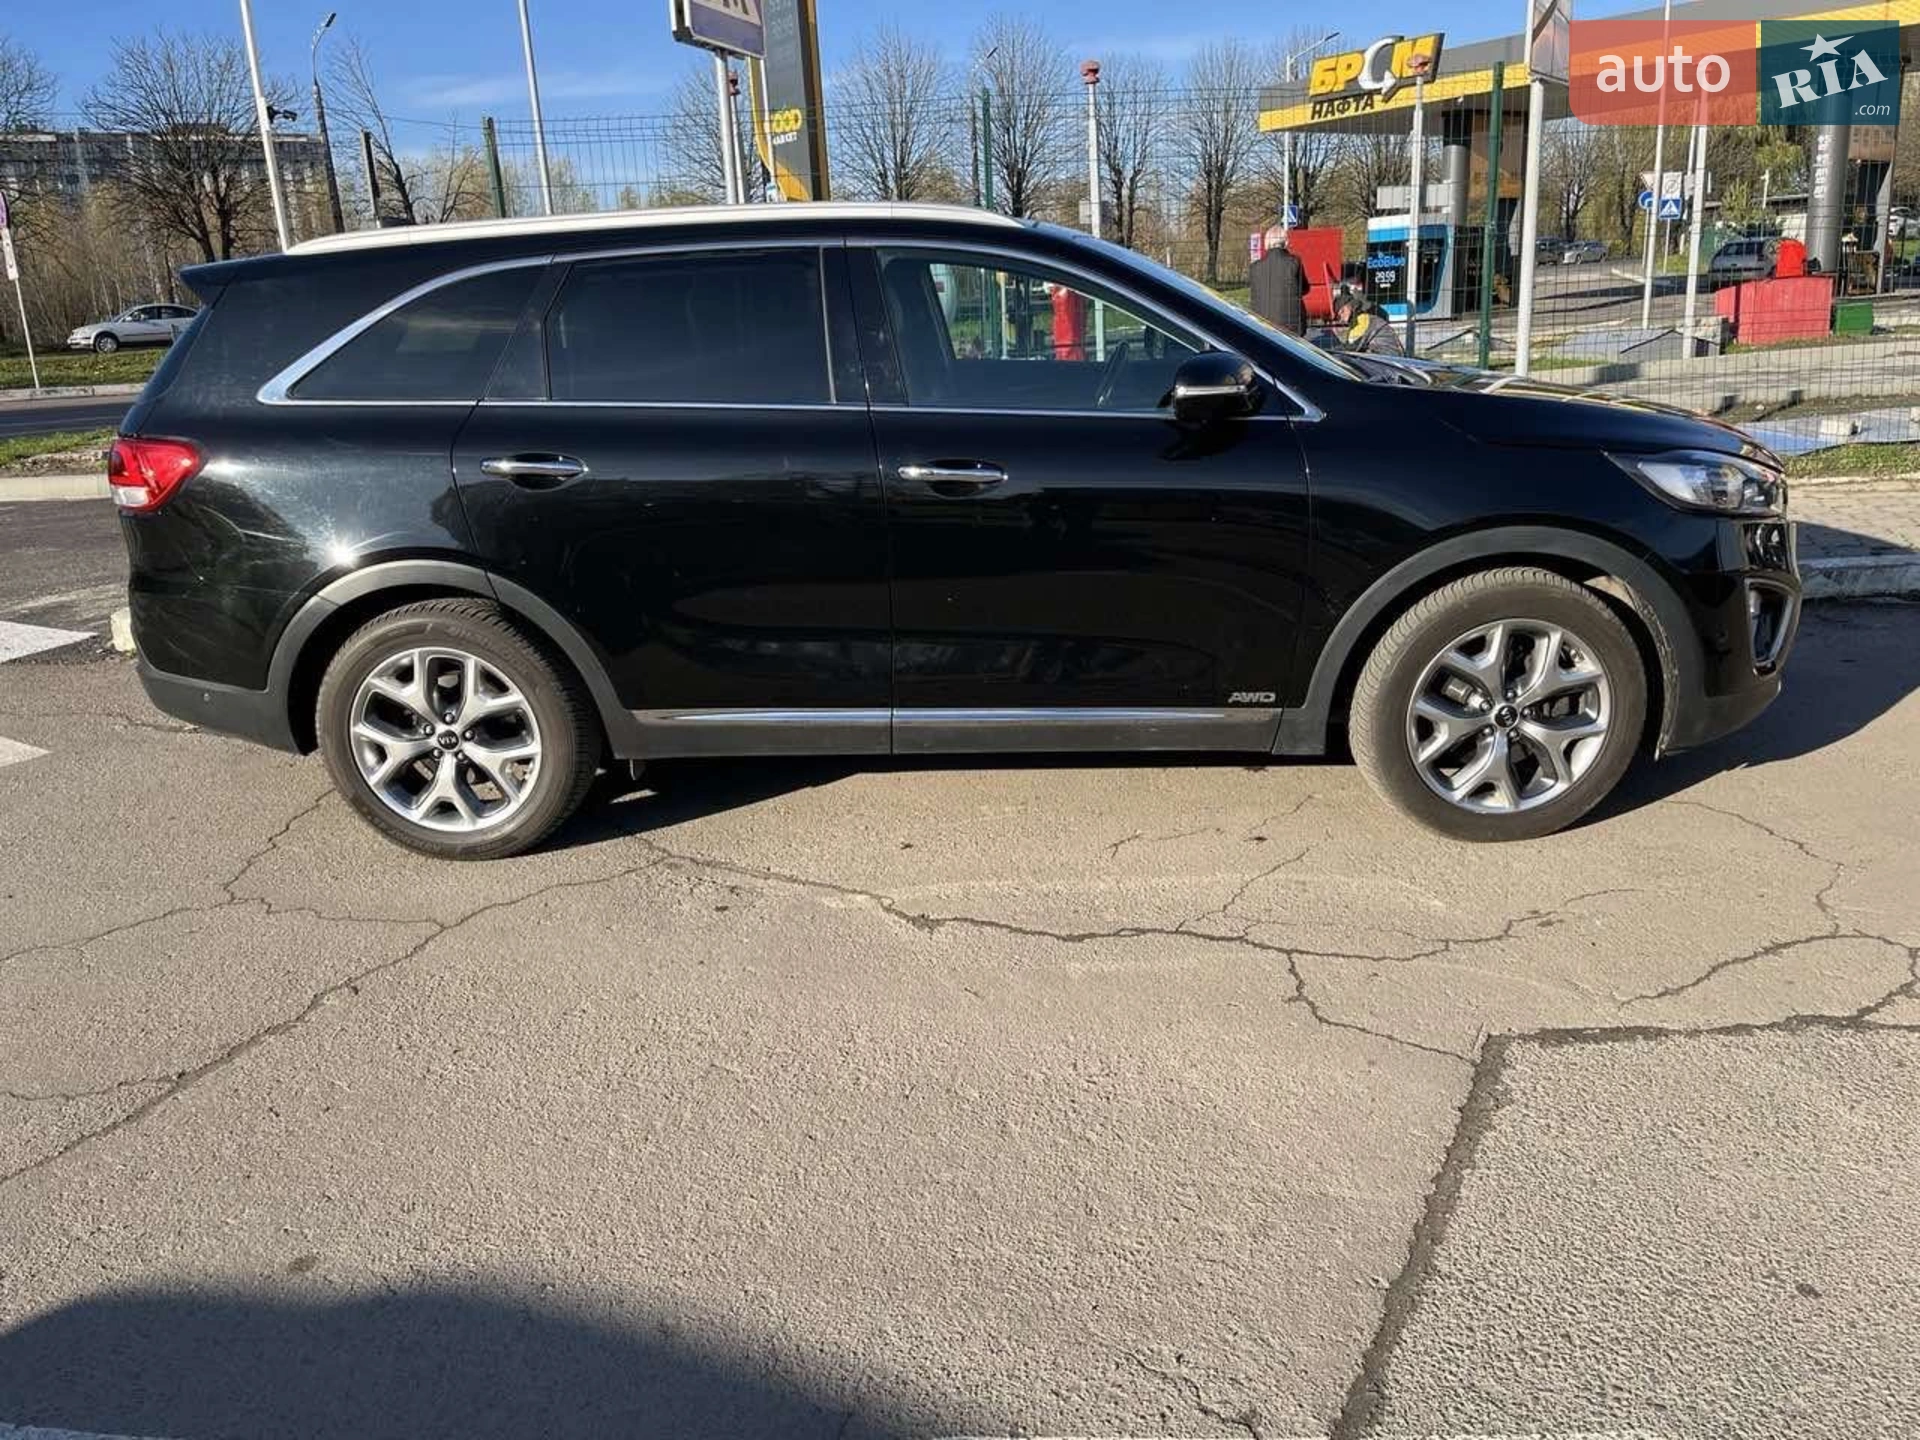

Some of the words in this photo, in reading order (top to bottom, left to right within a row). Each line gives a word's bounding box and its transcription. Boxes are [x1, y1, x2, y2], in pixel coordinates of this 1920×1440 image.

[1310, 95, 1374, 120] НАФТА
[769, 108, 802, 132] OOD
[1228, 692, 1276, 703] AWD
